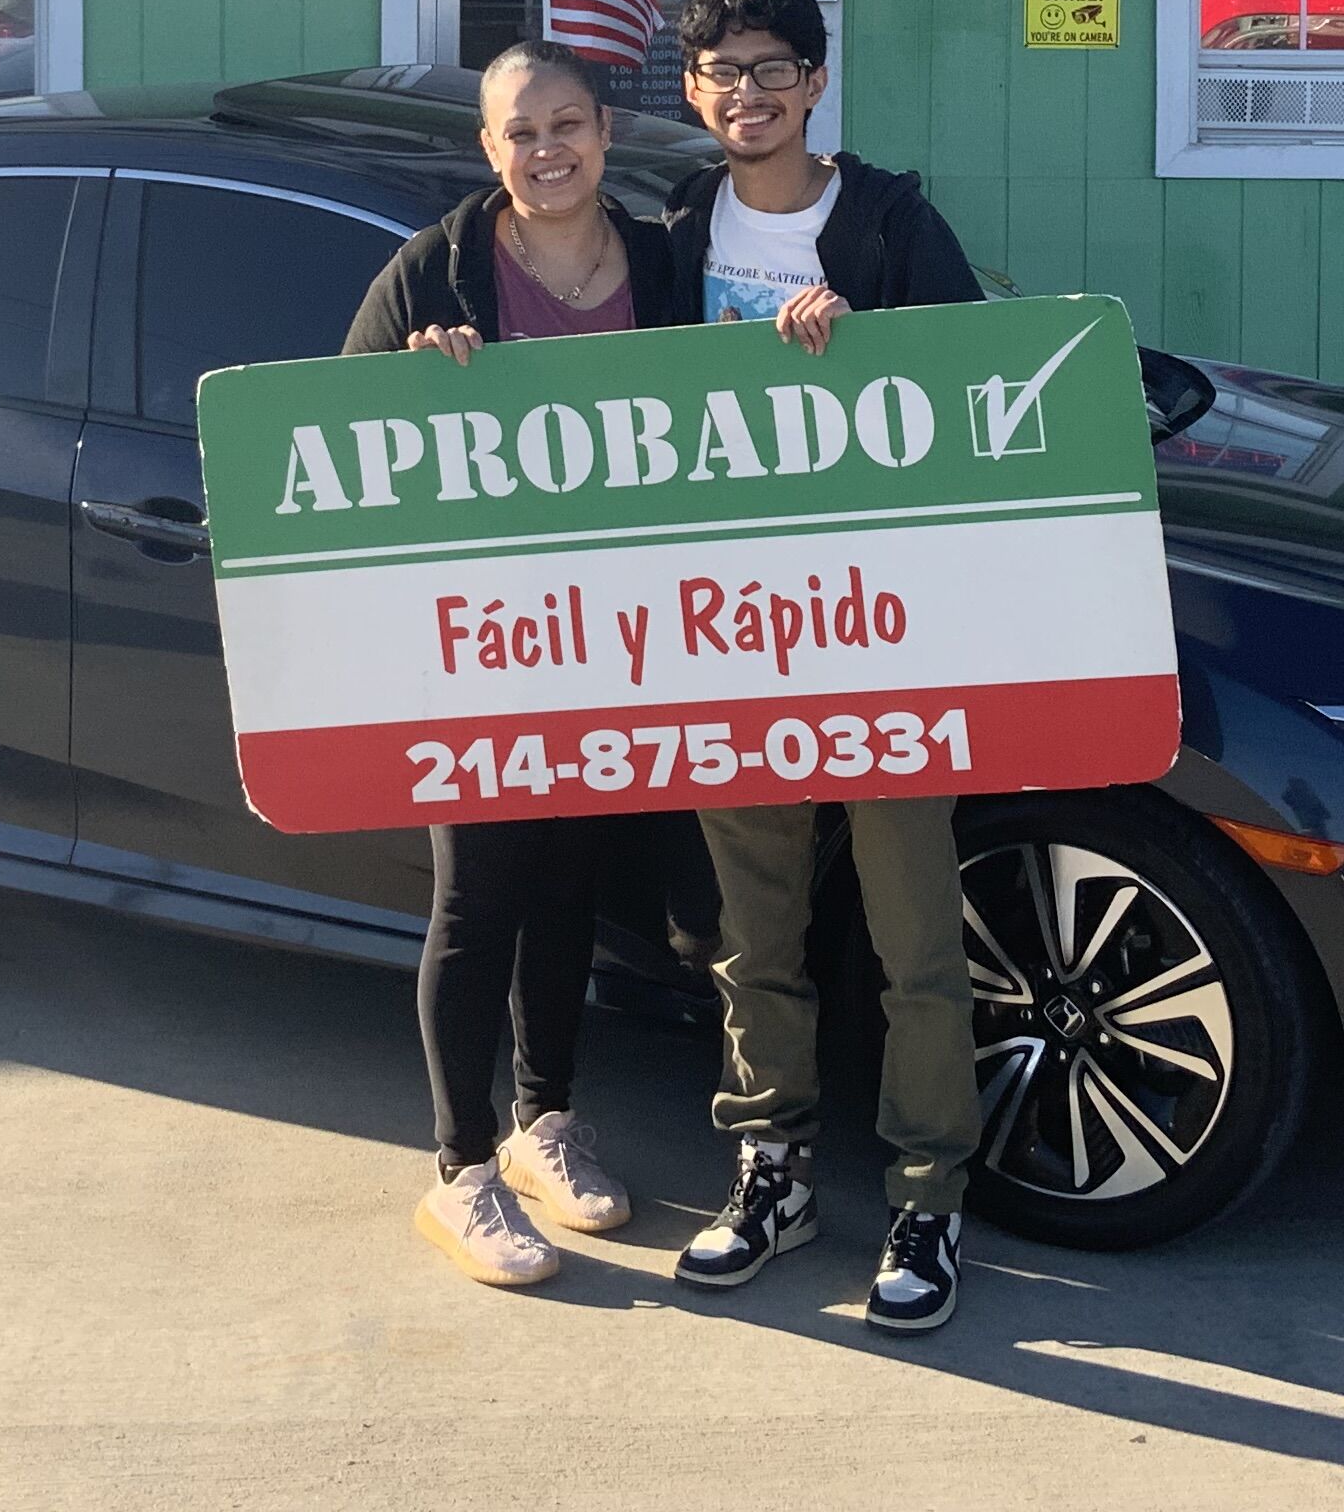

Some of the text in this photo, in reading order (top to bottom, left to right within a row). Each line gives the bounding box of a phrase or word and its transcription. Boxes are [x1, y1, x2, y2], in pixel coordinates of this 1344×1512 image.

[1030, 31, 1114, 42] YOU'RE ON CAMERA
[640, 95, 682, 104] CLOSED
[274, 375, 936, 515] APROBADO
[434, 565, 908, 686] Fácil y Rápido
[404, 708, 974, 803] 214-875-0331
